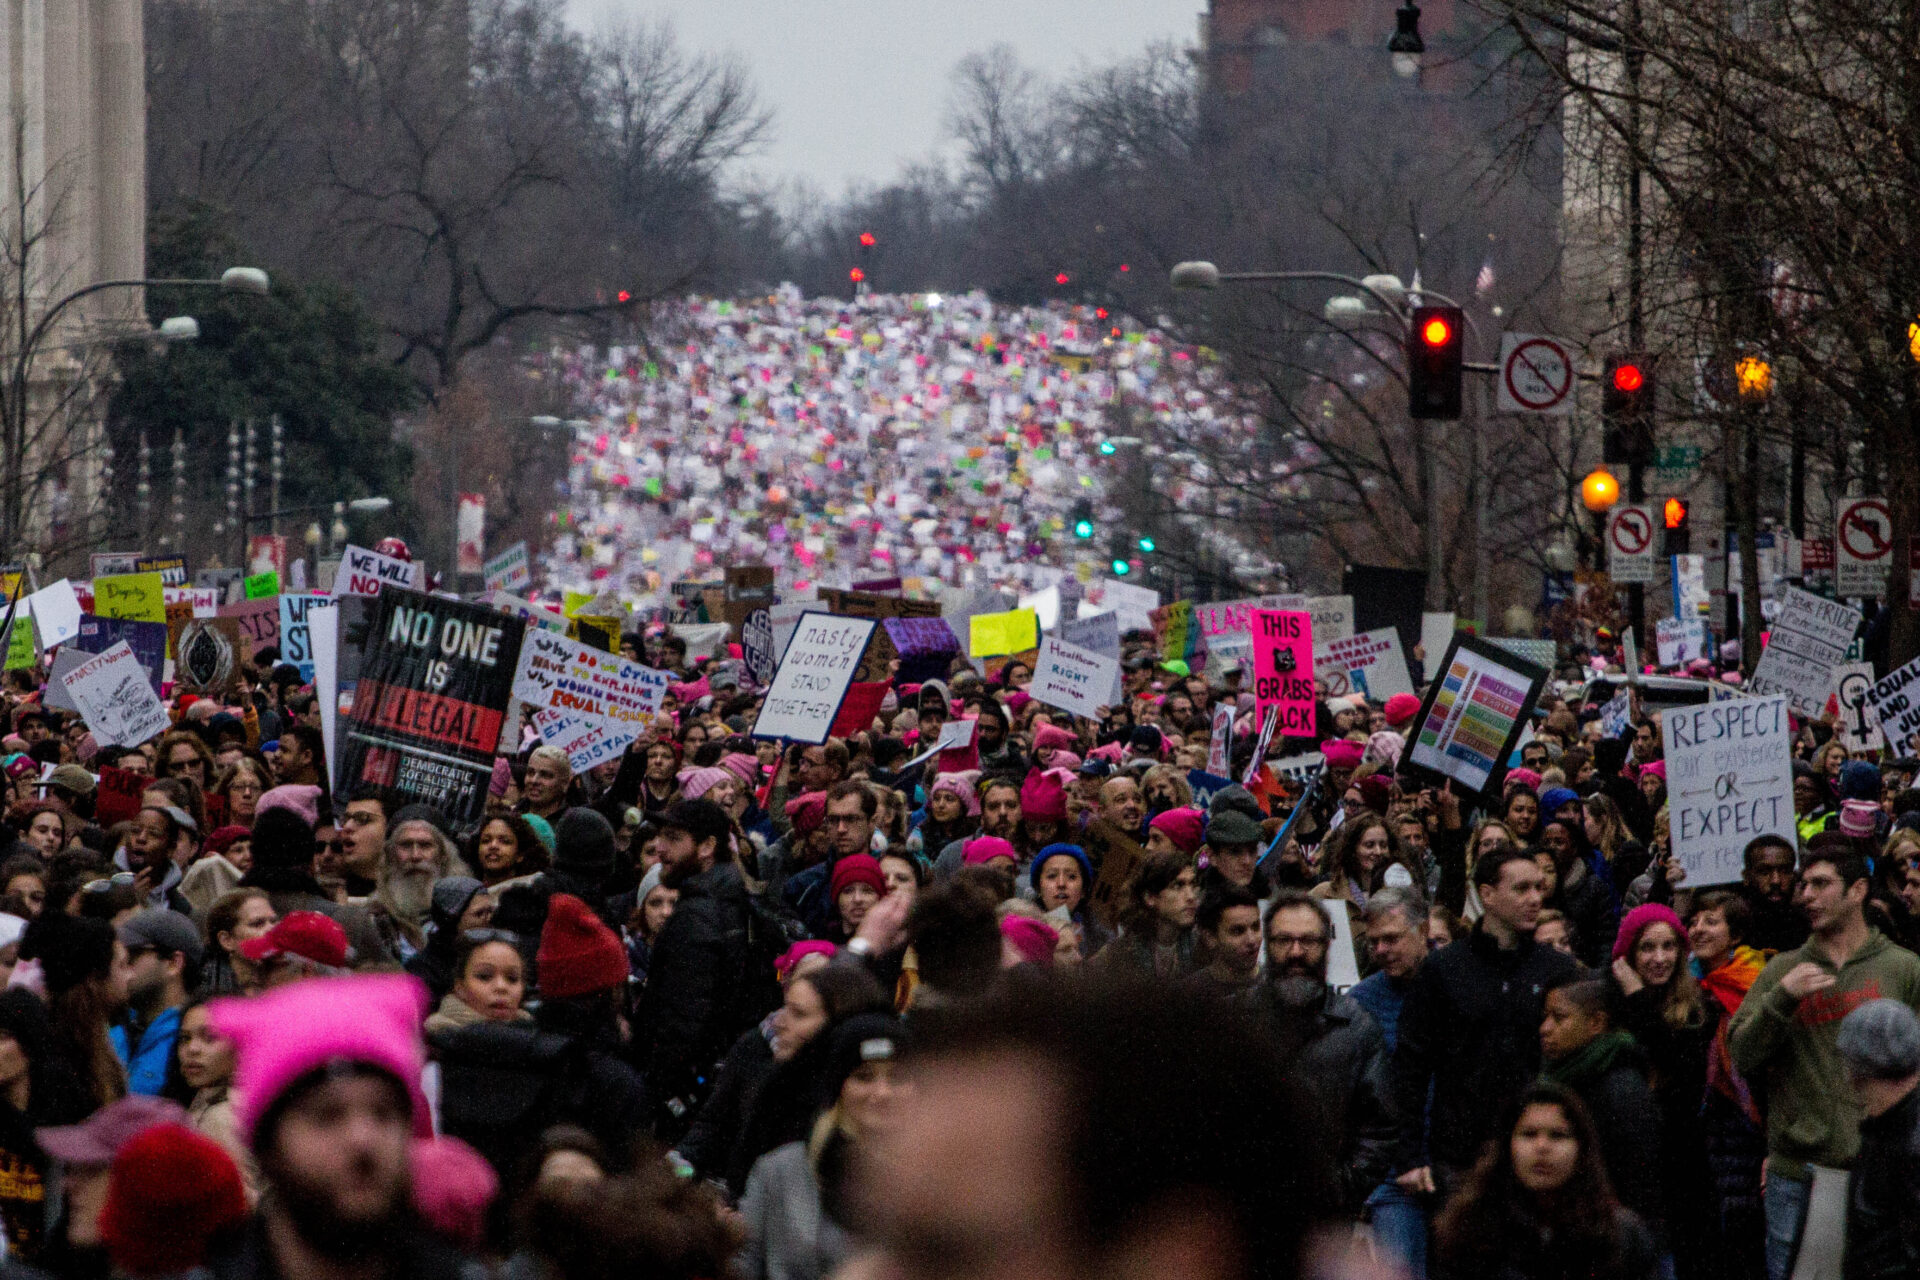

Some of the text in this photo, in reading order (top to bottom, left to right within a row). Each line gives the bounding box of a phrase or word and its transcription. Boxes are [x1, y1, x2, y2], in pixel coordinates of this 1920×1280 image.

[351, 552, 410, 585] WE WILL
[388, 605, 503, 666] NO ONE
[1260, 614, 1300, 638] THIS
[804, 626, 863, 654] nasty
[1314, 640, 1392, 667] NORMALIZE
[1329, 634, 1371, 652] NEVER
[424, 658, 449, 688] IS
[790, 650, 851, 670] women
[1052, 663, 1089, 684] RIGHT
[791, 673, 831, 692] STAND
[1256, 677, 1314, 701] GRABS
[368, 682, 479, 744] ILLEGAL
[549, 689, 605, 715] EQUAL
[768, 698, 832, 720] TOGETHER
[1879, 693, 1910, 723] AND
[1671, 699, 1785, 749] RESPECT
[1899, 708, 1920, 734] JU
[1714, 739, 1784, 770] existence
[400, 767, 459, 792] SOCIALISTS
[402, 756, 473, 783] DEMOCRATIC
[397, 777, 446, 800] AMERICA
[1714, 772, 1740, 800] OR
[1680, 795, 1783, 842] EXPECT
